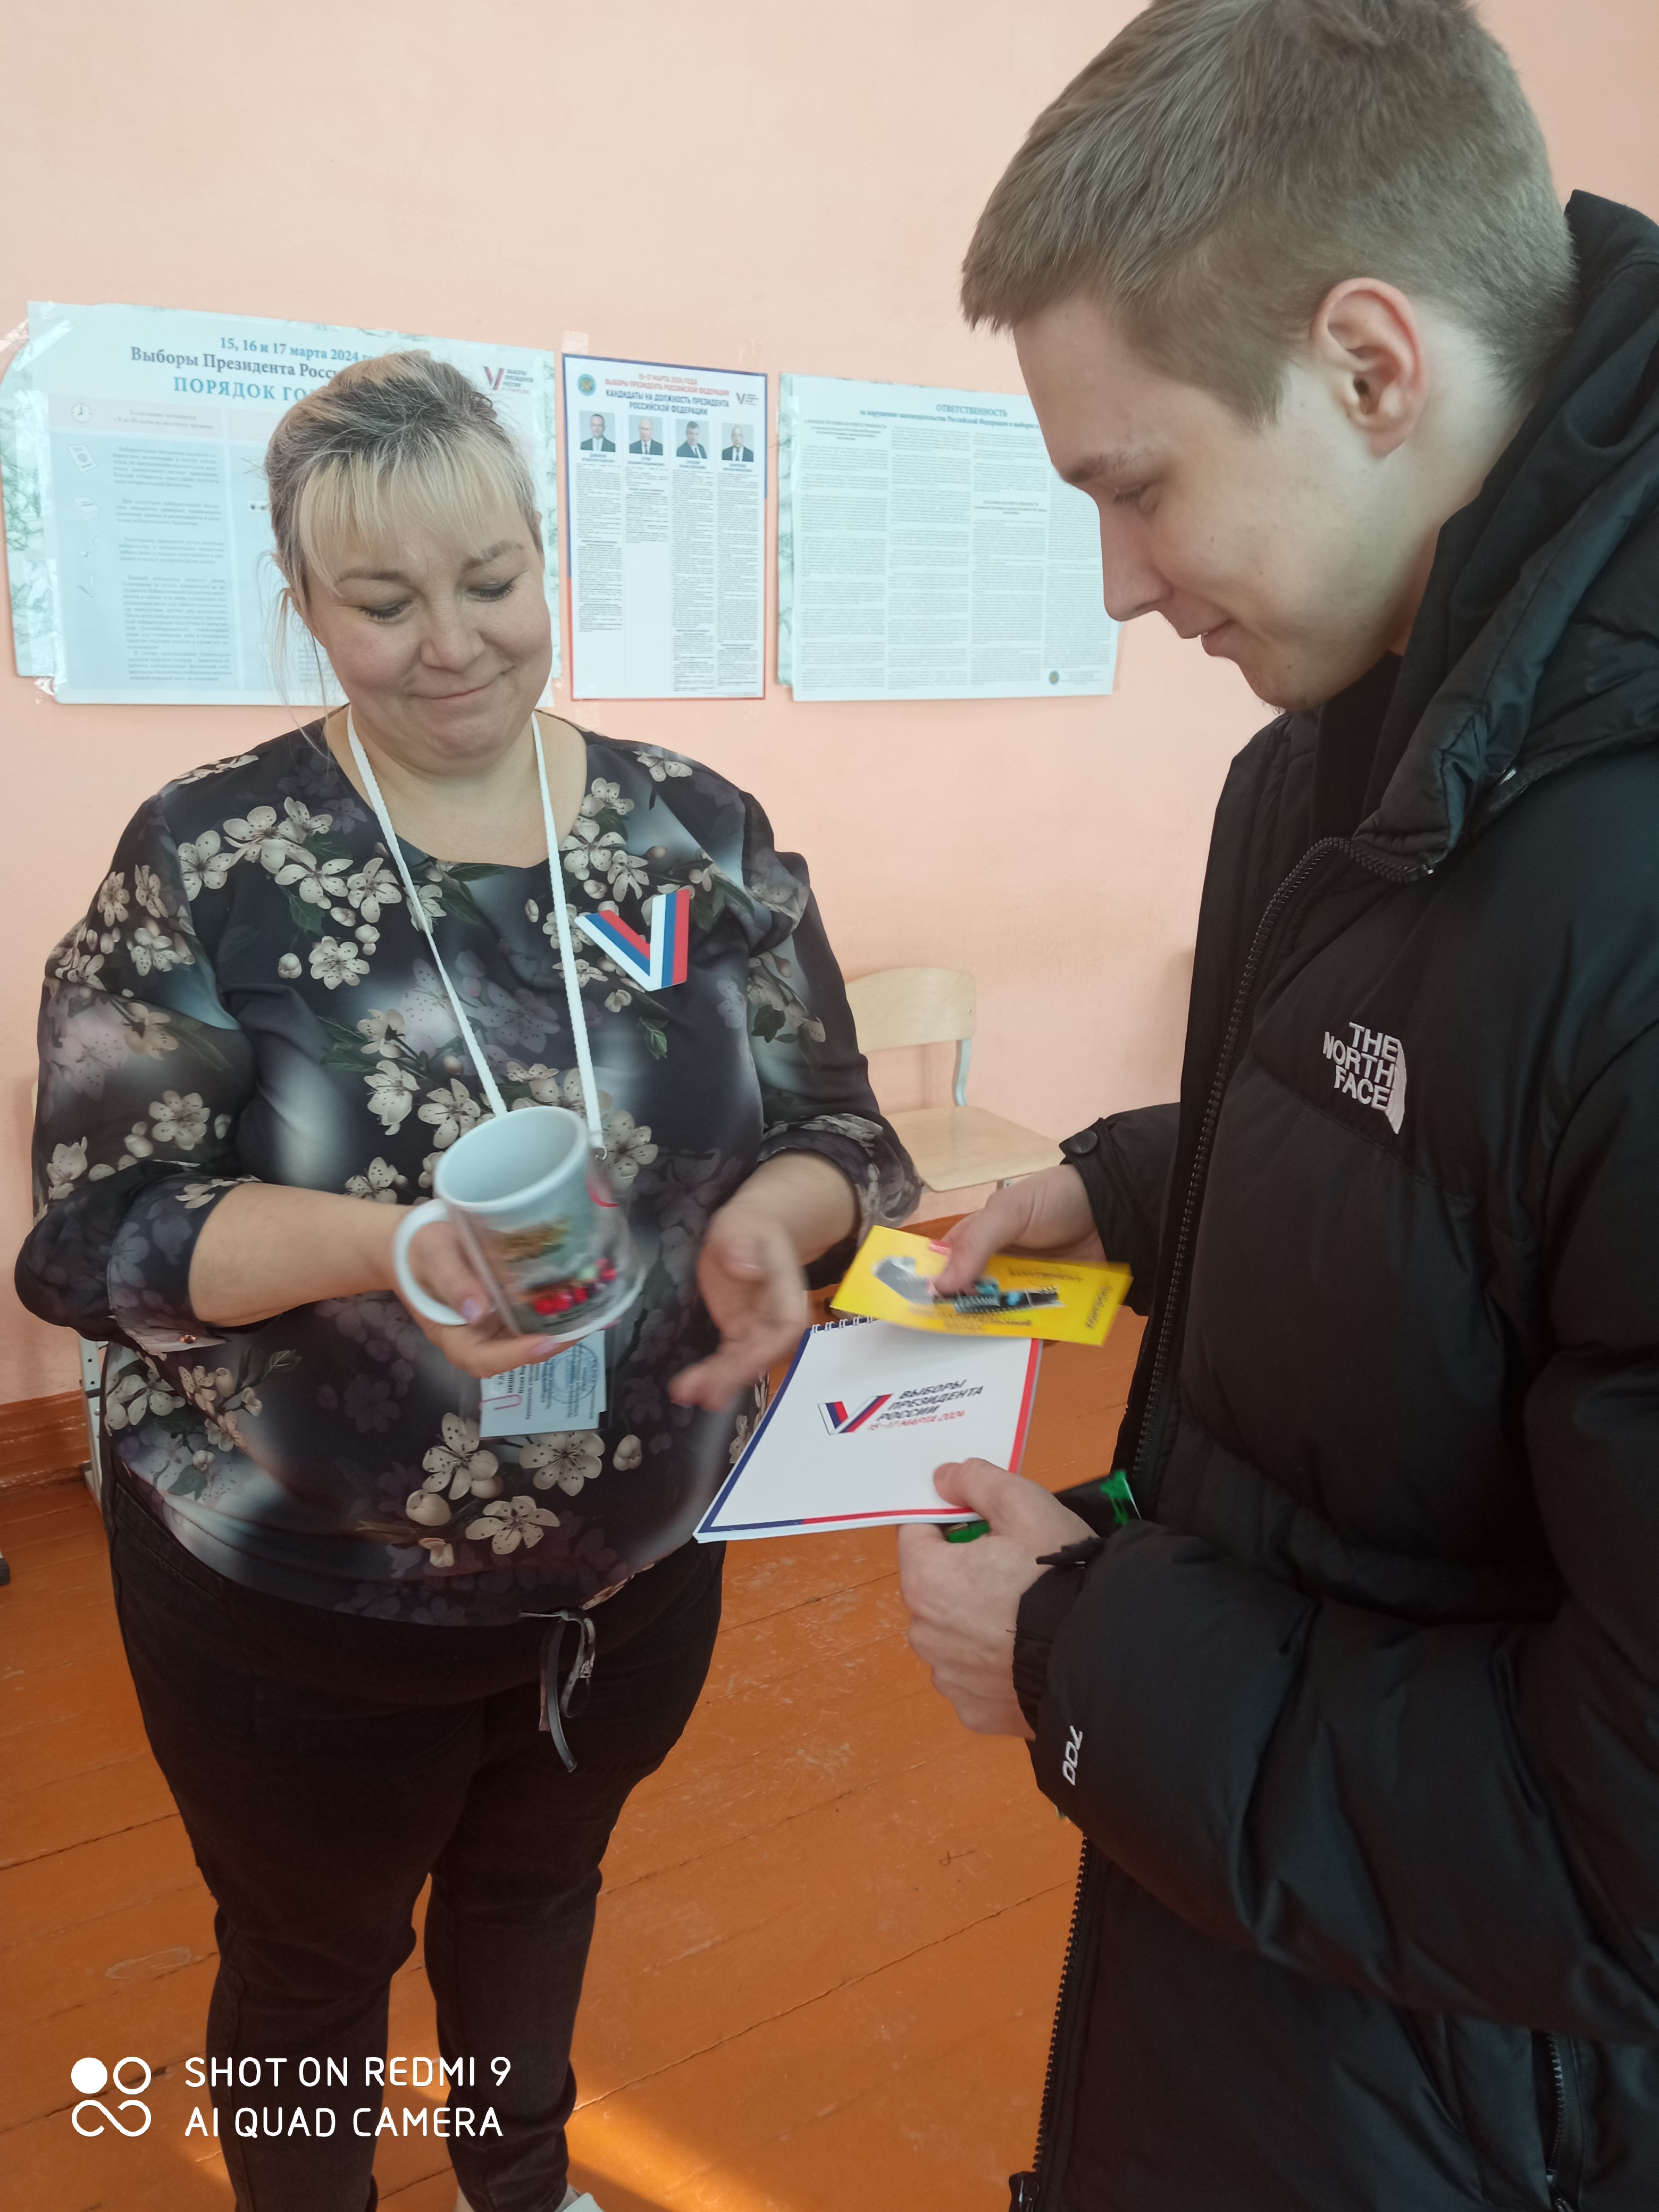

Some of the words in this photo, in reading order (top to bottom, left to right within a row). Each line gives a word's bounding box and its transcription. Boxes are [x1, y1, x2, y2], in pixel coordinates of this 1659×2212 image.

[130, 346, 199, 368] Выборы
[203, 353, 296, 376] Президента
[220, 337, 239, 351] 15,
[243, 339, 257, 351] 16
[259, 343, 269, 353] и
[273, 343, 287, 355] 17
[290, 347, 327, 361] марта
[330, 349, 359, 362] 2024
[173, 376, 275, 400] ПОРЯДОК
[606, 389, 643, 399] КАНДИДАТЫ
[655, 393, 691, 404] ДОЛЖНОСТЬ
[692, 397, 729, 407] ПРЕЗИДЕНТА
[629, 401, 669, 412] РОССИЙСКОЙ
[672, 405, 708, 415] ФЕДЕРАЦИИ
[936, 404, 1007, 417] ОТВЕТСТВЕННОСТЬ
[1349, 1021, 1401, 1062] THE
[1322, 1032, 1395, 1087] NORTH
[1334, 1065, 1390, 1111] FACE
[887, 1386, 983, 1410] ПРЕЗИДЕНТА
[899, 1379, 967, 1399] ВЫБОРЫ
[876, 1405, 940, 1421] РОССИИ
